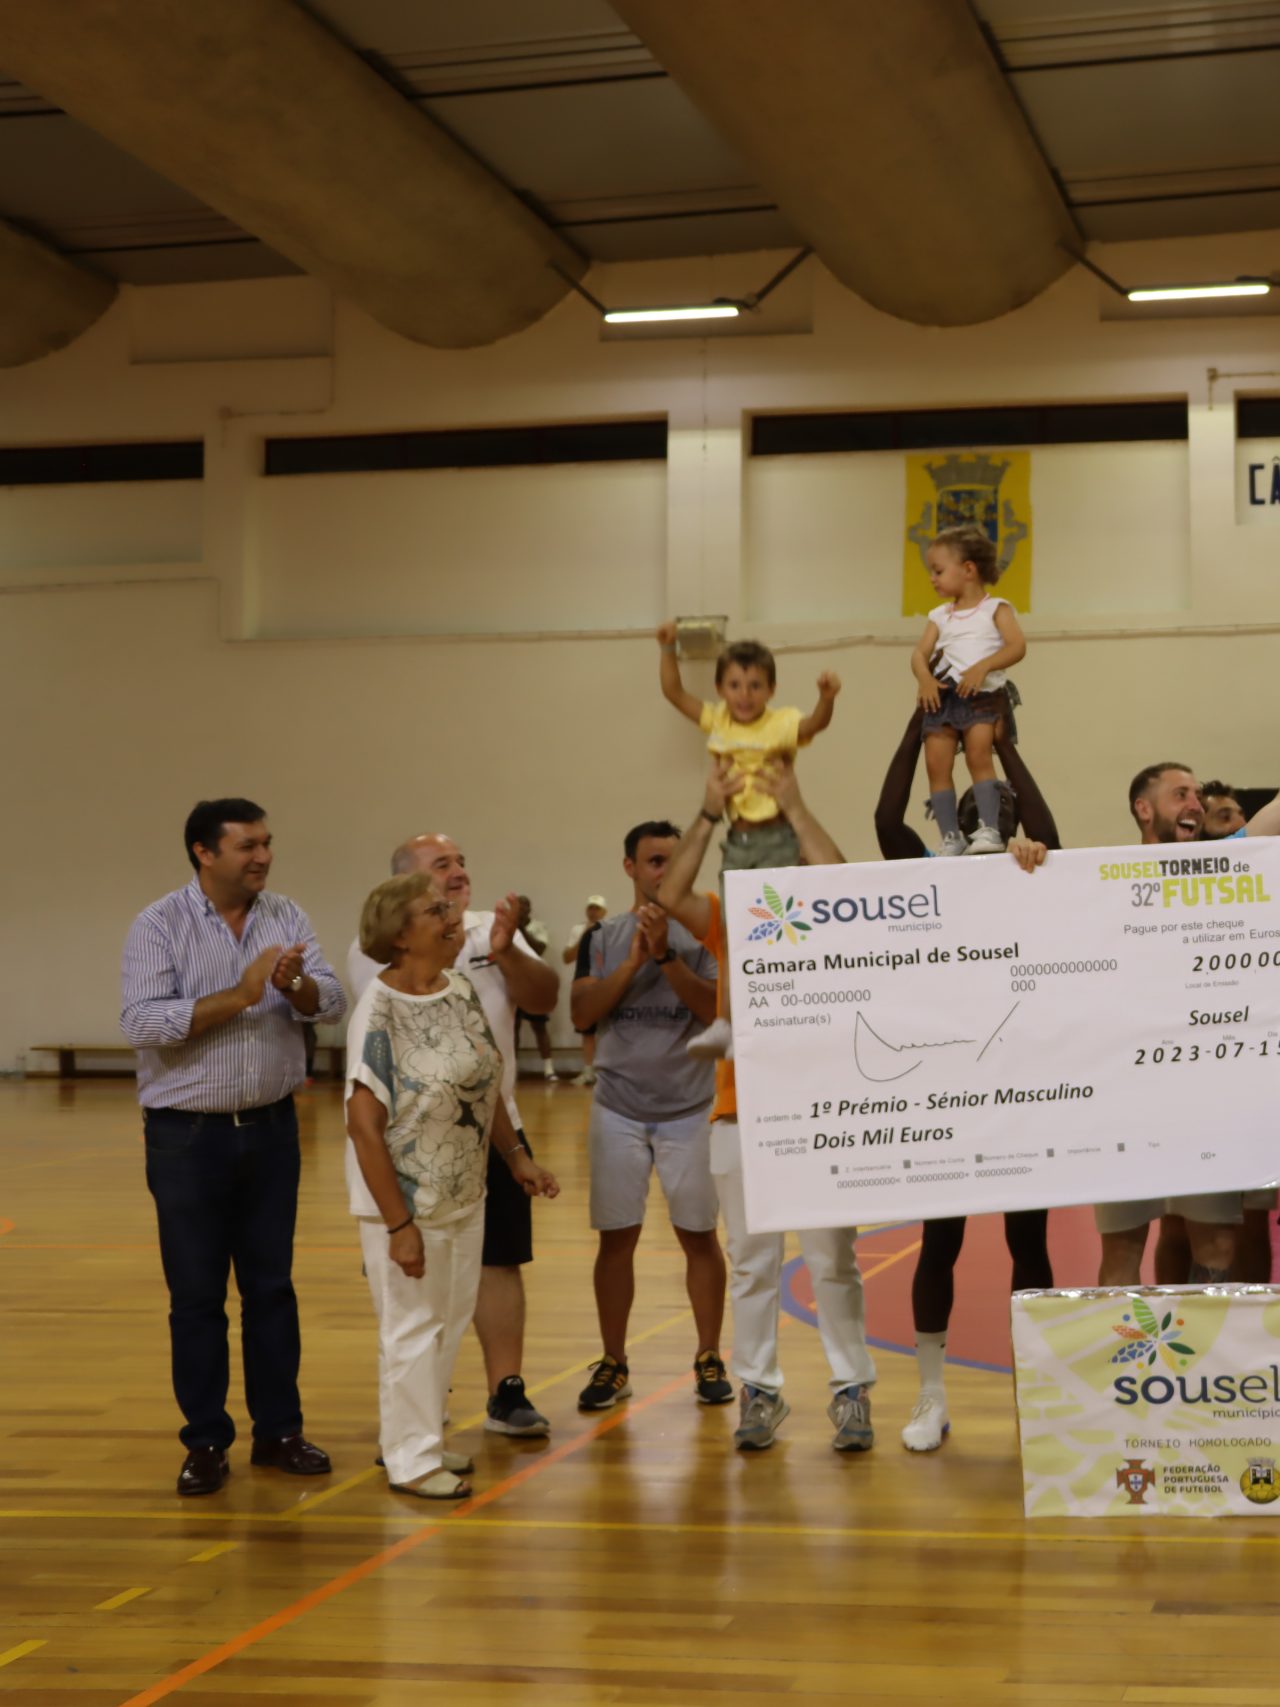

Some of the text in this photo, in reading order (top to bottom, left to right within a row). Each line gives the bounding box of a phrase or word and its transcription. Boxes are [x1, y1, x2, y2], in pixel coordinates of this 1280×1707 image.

[1233, 860, 1250, 873] de
[1161, 873, 1271, 909] FUTSAL
[811, 884, 942, 924] sousel
[1123, 917, 1245, 937] Pague por este cheque
[1182, 928, 1280, 945] a utilizar em Euros
[742, 942, 1019, 976] Câmara Municipal de Sousel
[748, 979, 795, 994] Sousel
[1011, 980, 1037, 994] 000
[748, 995, 769, 1009] AA
[754, 1012, 832, 1028] Assinatura(s)
[1188, 1005, 1250, 1027] Sousel
[838, 1095, 908, 1117] Prémio
[926, 1090, 989, 1110] Sénior
[993, 1082, 1094, 1106] Masculino
[813, 1125, 954, 1150] Dois Mil Euros
[774, 1145, 807, 1157] EUROS
[1124, 1437, 1272, 1449] TORNEIO HOMOLOGADO
[1162, 1463, 1221, 1474] FEDERAÇÃO
[1163, 1475, 1229, 1484] PORTUGUESA
[1164, 1485, 1223, 1494] DE FUTEBOL
